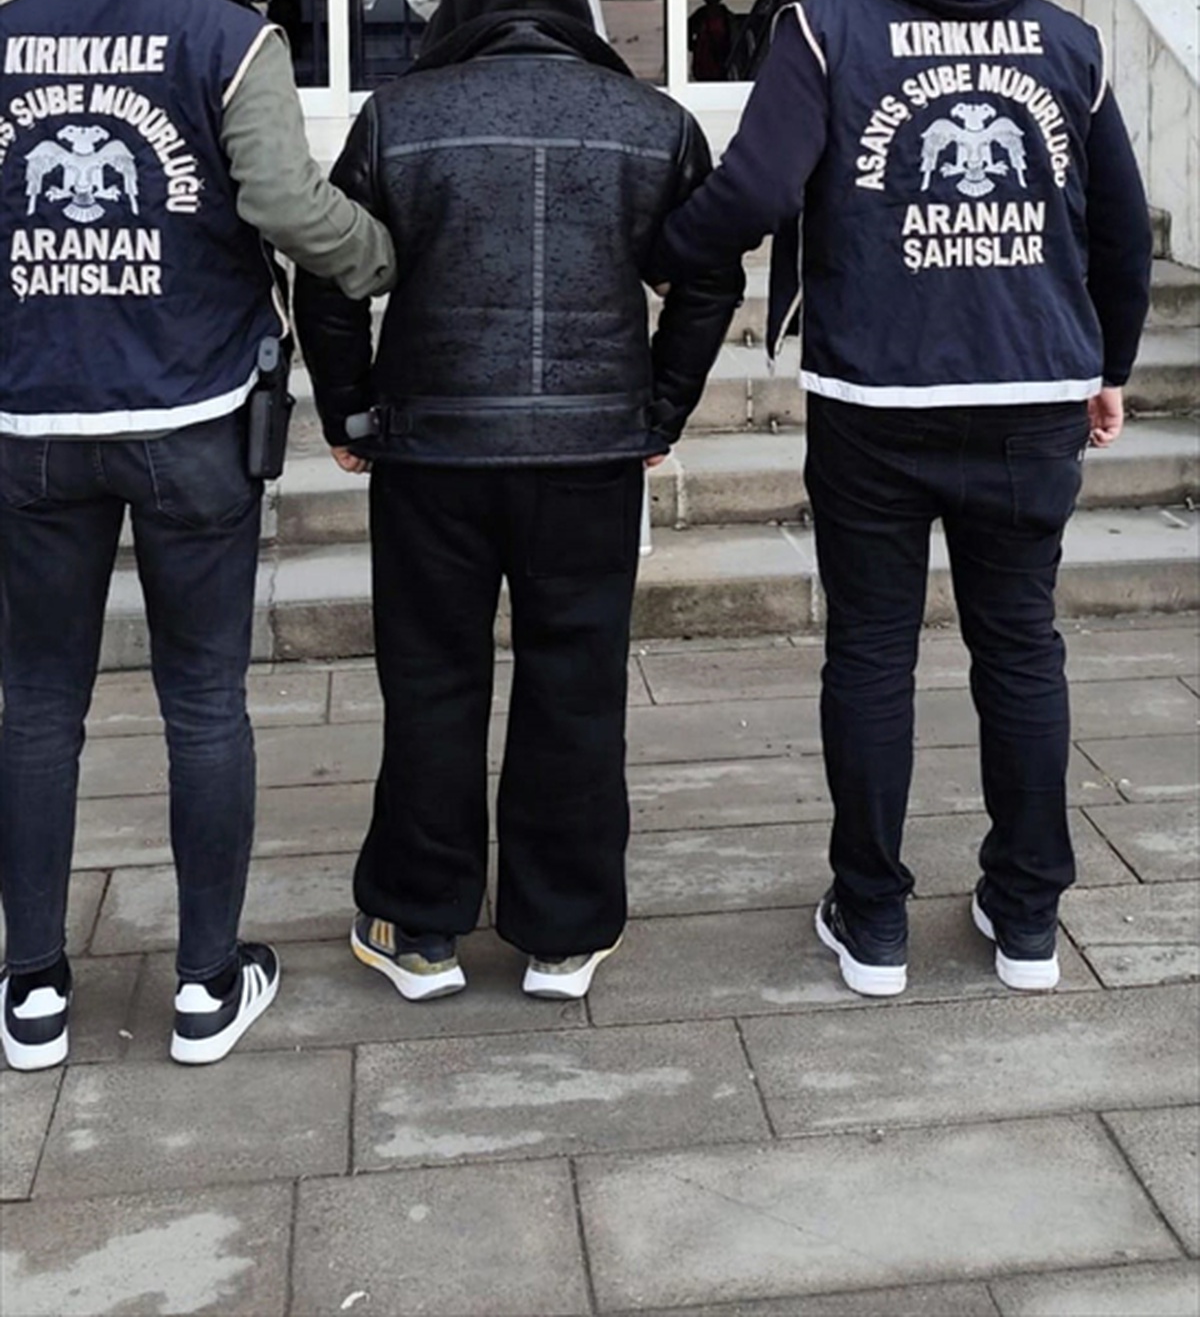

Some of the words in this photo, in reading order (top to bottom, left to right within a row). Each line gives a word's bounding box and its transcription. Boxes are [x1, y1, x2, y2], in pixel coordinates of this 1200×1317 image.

[3, 34, 169, 75] KIRIKKALE
[889, 20, 1044, 58] KIRIKKALE
[902, 63, 974, 109] ŞUBE
[10, 84, 85, 131] ŞUBE
[902, 201, 1046, 236] ARANAN
[10, 228, 161, 262] ARANAN
[903, 235, 1045, 275] ŞAHISLAR
[10, 263, 162, 304] ŞAHISLAR
